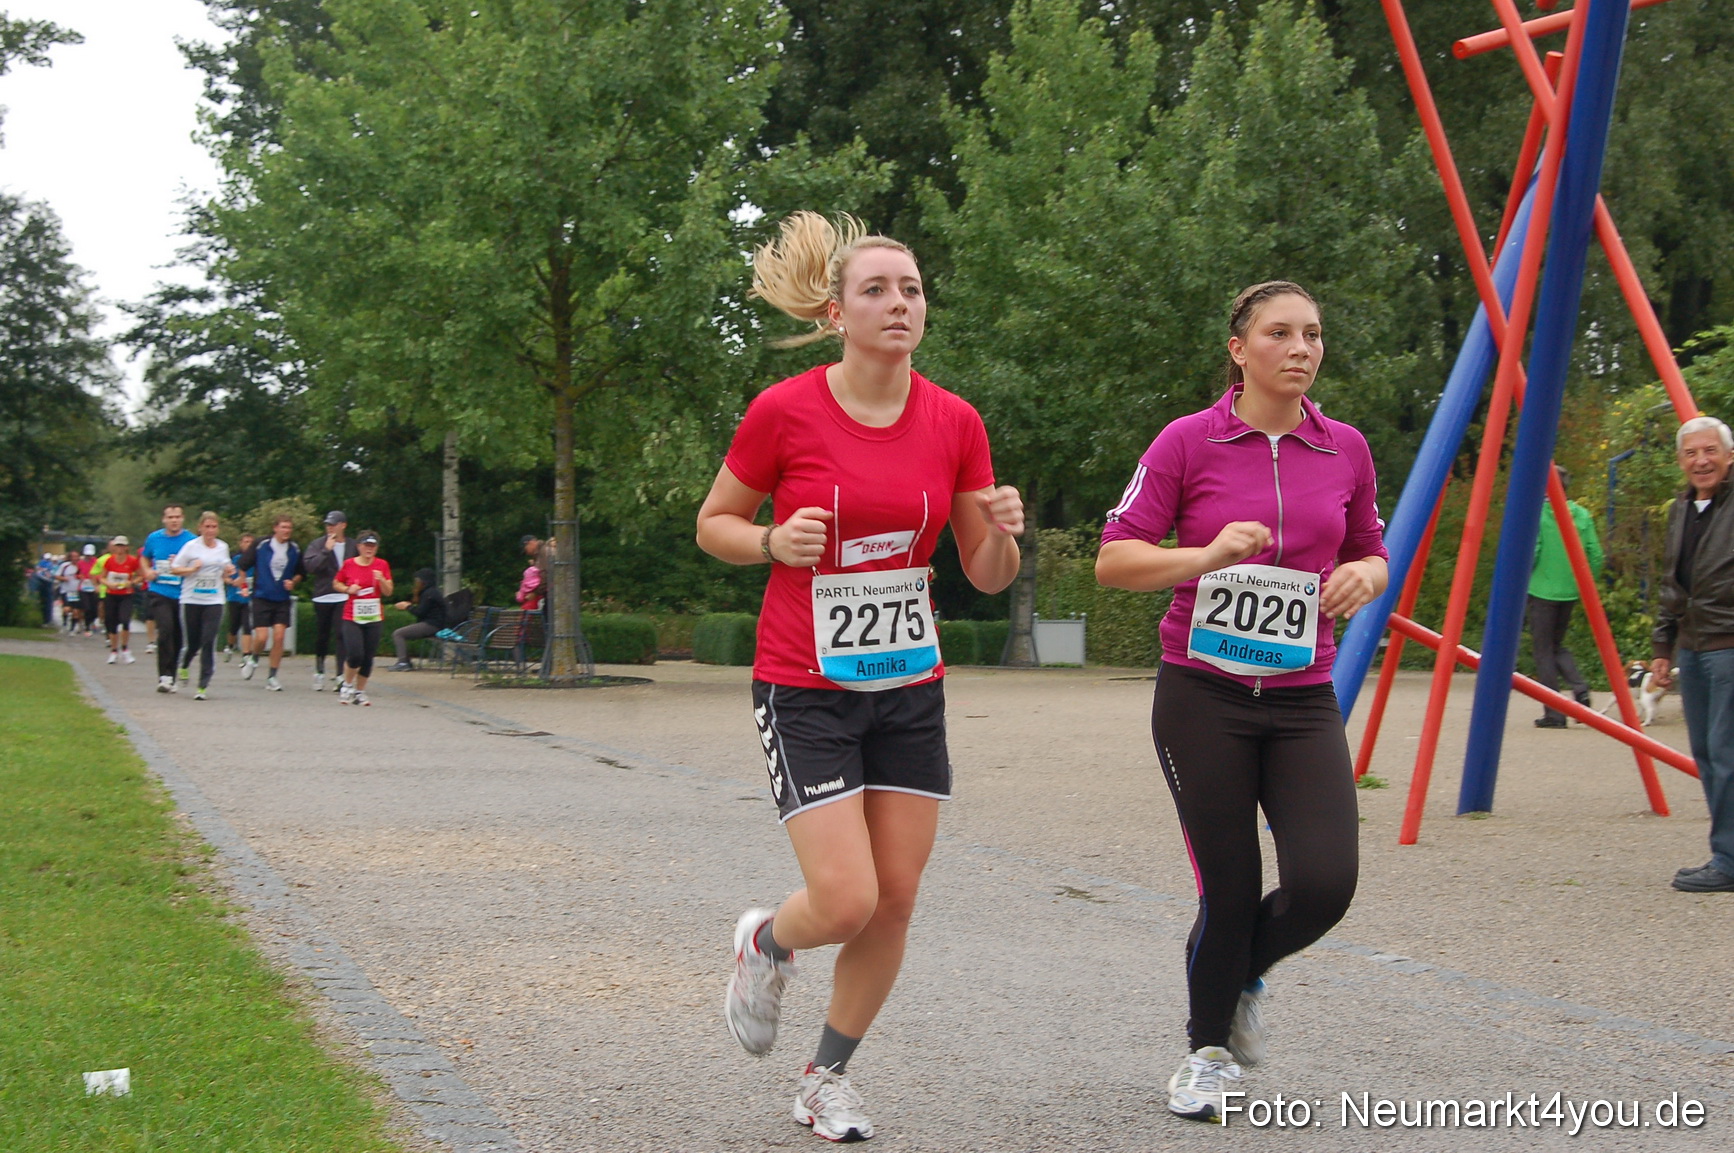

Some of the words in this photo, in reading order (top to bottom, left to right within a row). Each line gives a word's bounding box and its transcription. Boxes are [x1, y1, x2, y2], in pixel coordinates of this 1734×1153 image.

[862, 540, 894, 554] DEHN
[816, 586, 859, 599] PARTL
[863, 582, 913, 596] Neumarkt
[1203, 572, 1244, 583] PARTL
[1247, 575, 1300, 592] Neumarkt
[829, 598, 925, 649] 2275
[1205, 587, 1307, 639] 2029
[1217, 639, 1283, 664] Andreas
[856, 656, 907, 677] Annika
[803, 776, 845, 797] hummel
